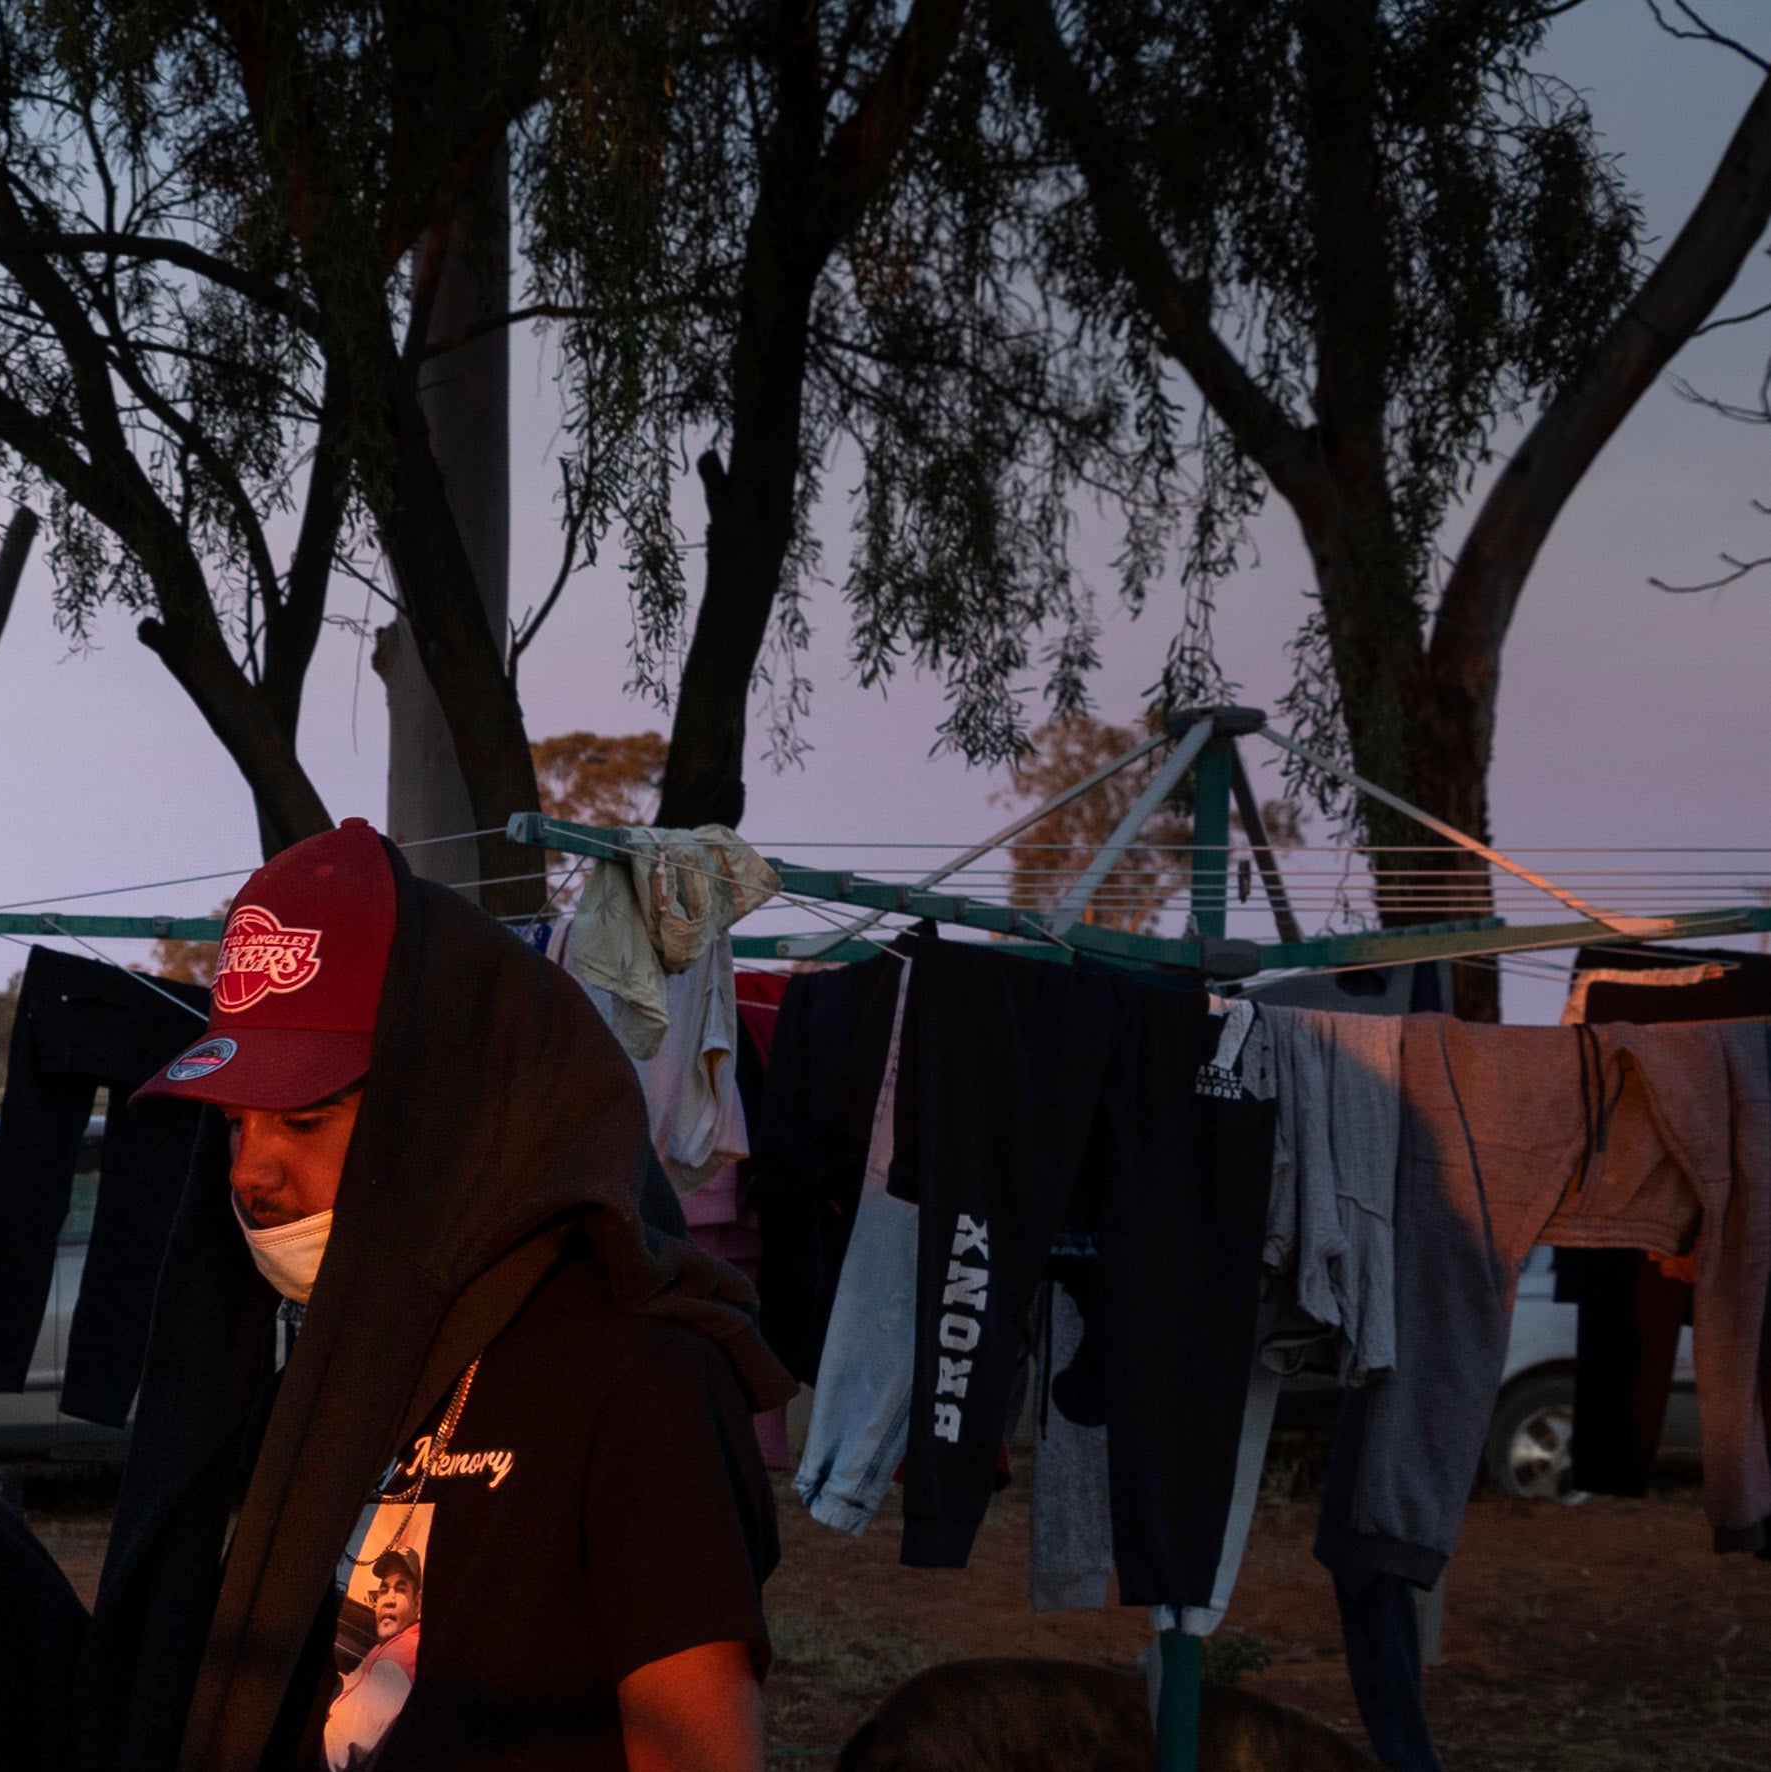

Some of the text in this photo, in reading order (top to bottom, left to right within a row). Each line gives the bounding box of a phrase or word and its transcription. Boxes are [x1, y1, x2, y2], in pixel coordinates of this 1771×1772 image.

[246, 933, 311, 947] ANGELES
[933, 1213, 990, 1443] BRONX
[406, 1435, 514, 1489] Memory
